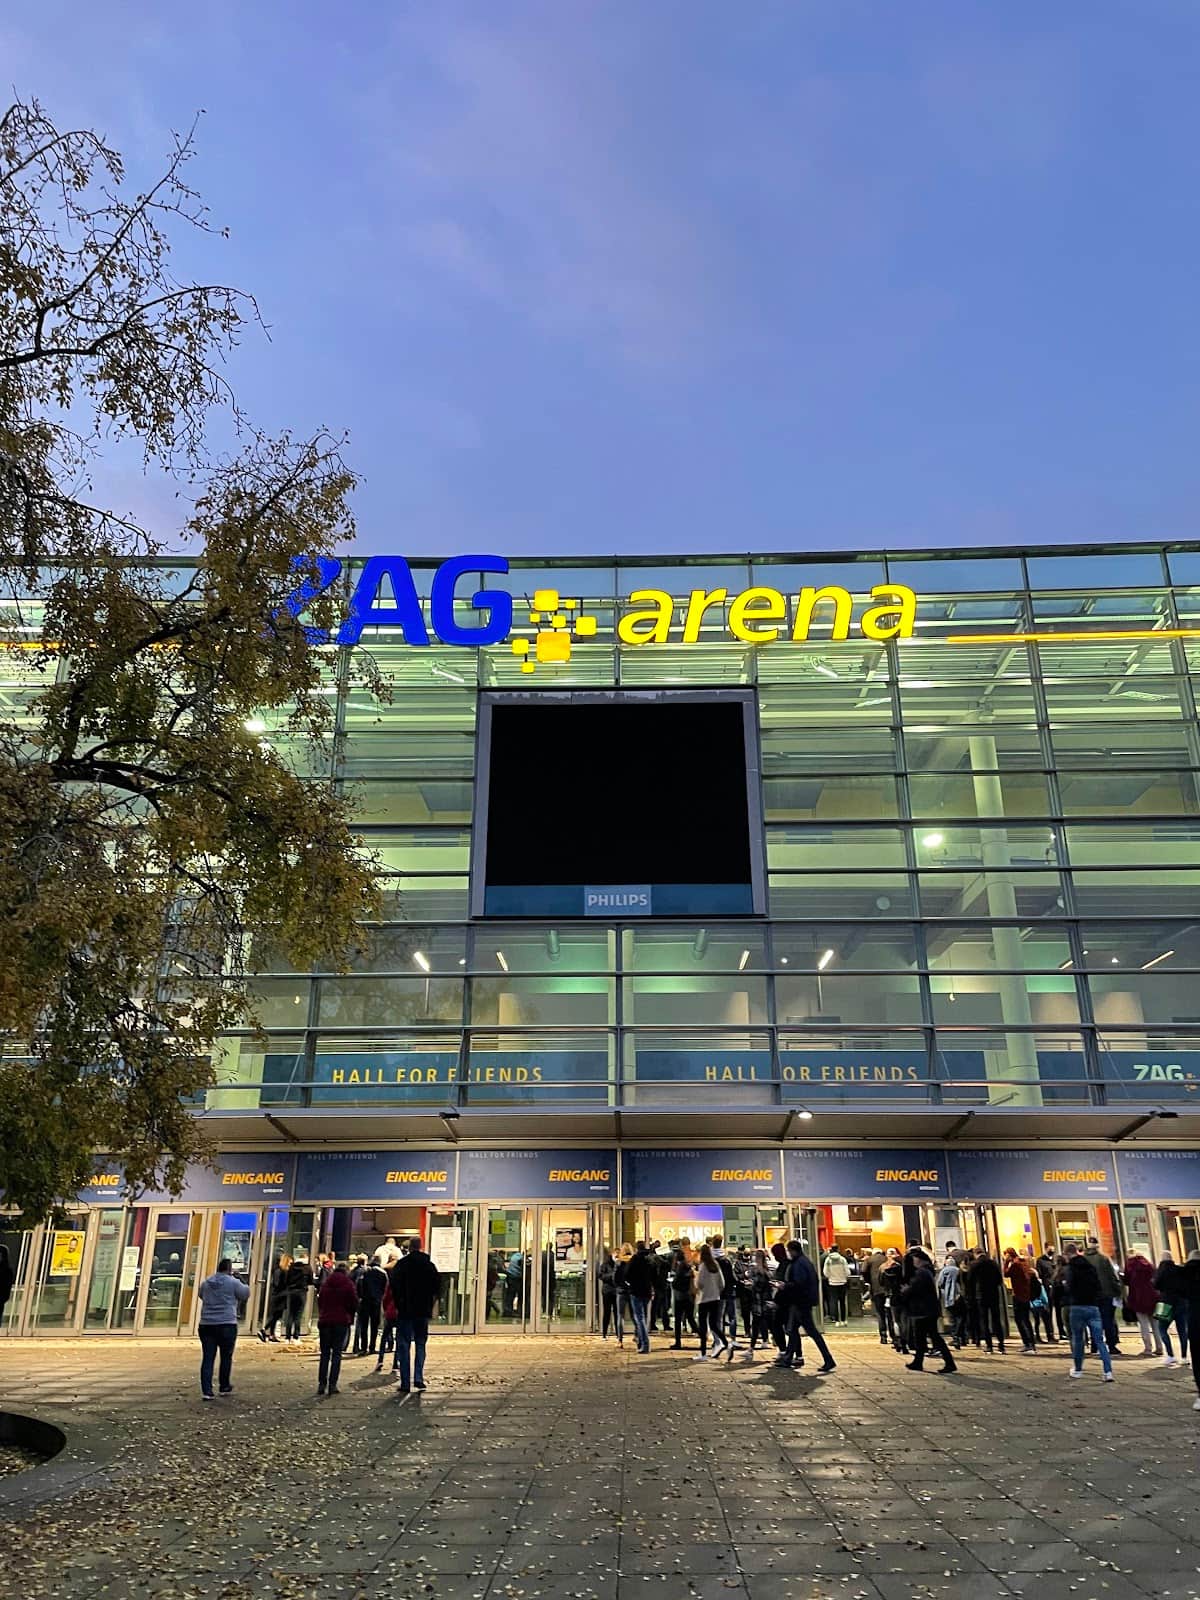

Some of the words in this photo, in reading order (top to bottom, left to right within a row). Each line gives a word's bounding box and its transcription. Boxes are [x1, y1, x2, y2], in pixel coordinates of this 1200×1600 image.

[617, 583, 917, 644] arena
[588, 894, 648, 906] PHILIPS
[332, 1068, 383, 1083] HALL
[397, 1068, 438, 1083] FOR
[447, 1067, 543, 1082] FIENDS
[705, 1066, 757, 1081] HALL
[782, 1066, 811, 1080] OR
[821, 1066, 919, 1081] FRIENDS
[222, 1172, 284, 1185] EINGANG
[385, 1171, 447, 1183] EINGANG
[548, 1170, 609, 1182] EINGANG
[711, 1170, 773, 1182] EINGANG
[875, 1170, 938, 1182] EINGANG
[1043, 1170, 1107, 1182] EINGANG
